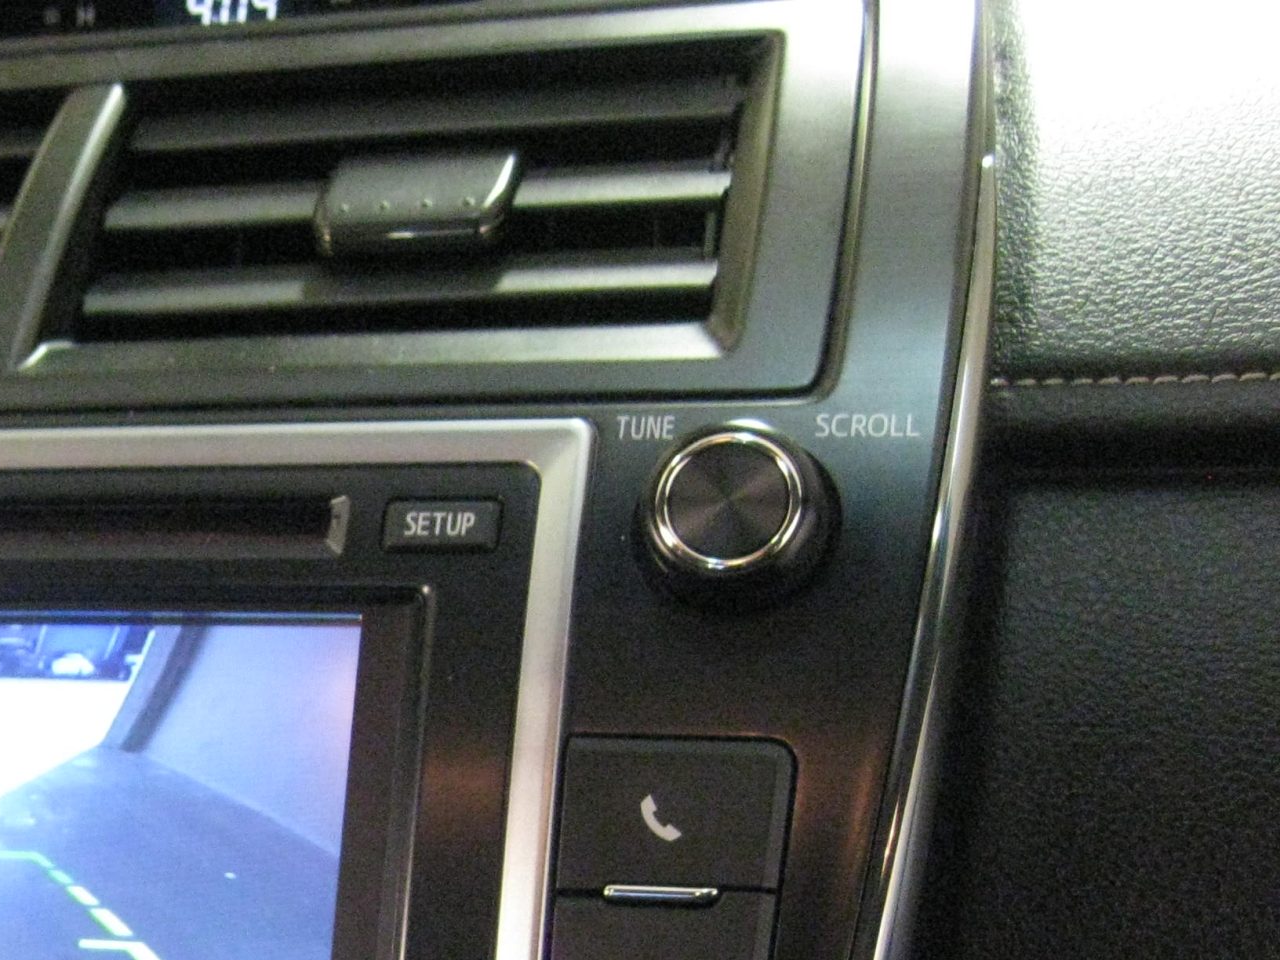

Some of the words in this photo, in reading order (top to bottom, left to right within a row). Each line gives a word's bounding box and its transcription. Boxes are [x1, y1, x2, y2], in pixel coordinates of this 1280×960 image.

[617, 414, 676, 441] TUNE
[814, 413, 921, 438] SCROLL
[403, 511, 476, 538] SETUP
